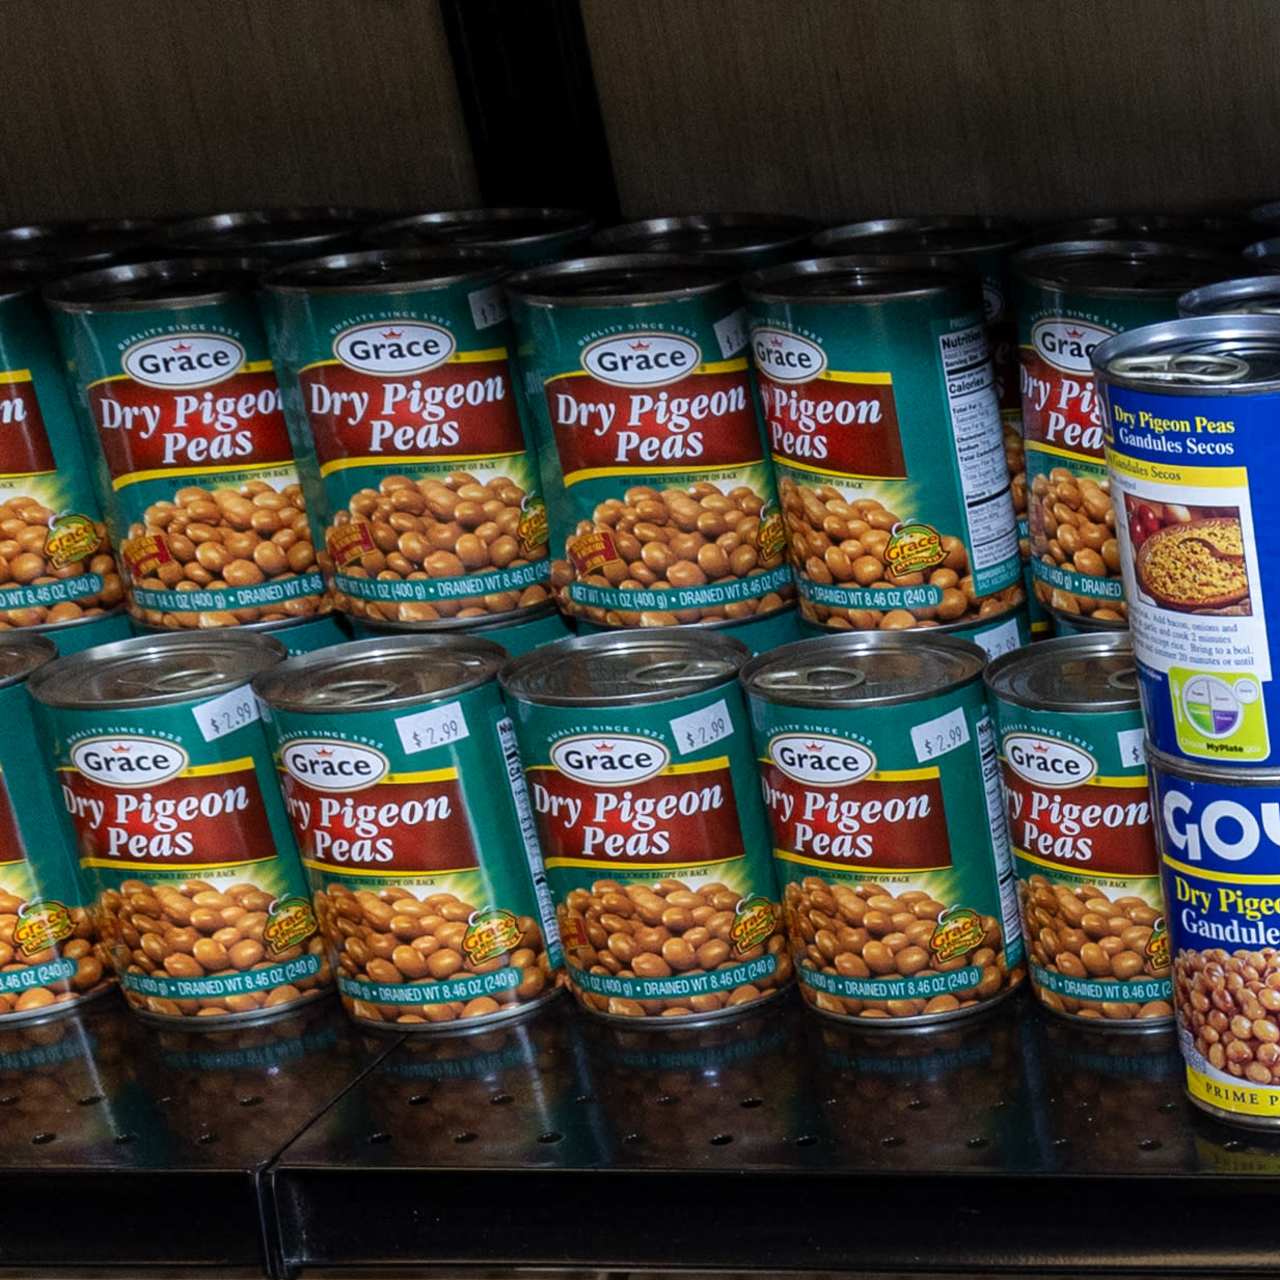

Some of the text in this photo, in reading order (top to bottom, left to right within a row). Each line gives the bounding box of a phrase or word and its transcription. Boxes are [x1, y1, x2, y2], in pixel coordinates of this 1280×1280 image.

[138, 348, 231, 375] Grace
[350, 338, 442, 365] Grace
[597, 348, 687, 375] Grace
[311, 375, 505, 422] Dry Pigeon
[556, 385, 747, 435] Dry Pigeon
[102, 398, 162, 438] Dry
[369, 416, 460, 452] Peas
[1113, 405, 1235, 438] Dry Pigeon Peas
[163, 428, 254, 463] Peas
[615, 428, 703, 462] Peas
[1119, 429, 1234, 455] Gandules Secos
[83, 749, 171, 773] Grace
[291, 753, 371, 778] Grace
[563, 747, 653, 773] Grace
[777, 749, 860, 775] Grace
[1006, 750, 1081, 776] Grace
[116, 784, 248, 831] Pigeon
[320, 795, 452, 839] Pigeon
[533, 784, 724, 834] Dry Pigeon
[805, 790, 931, 838] Pigeon
[108, 829, 194, 859] Peas
[315, 830, 394, 863] Peas
[582, 825, 671, 858] Peas
[794, 830, 874, 861] Peas
[1175, 876, 1211, 913] Dry
[643, 977, 689, 995] DRAINED
[691, 977, 708, 993] WT
[710, 971, 733, 991] 8.46
[735, 970, 746, 988] OZ
